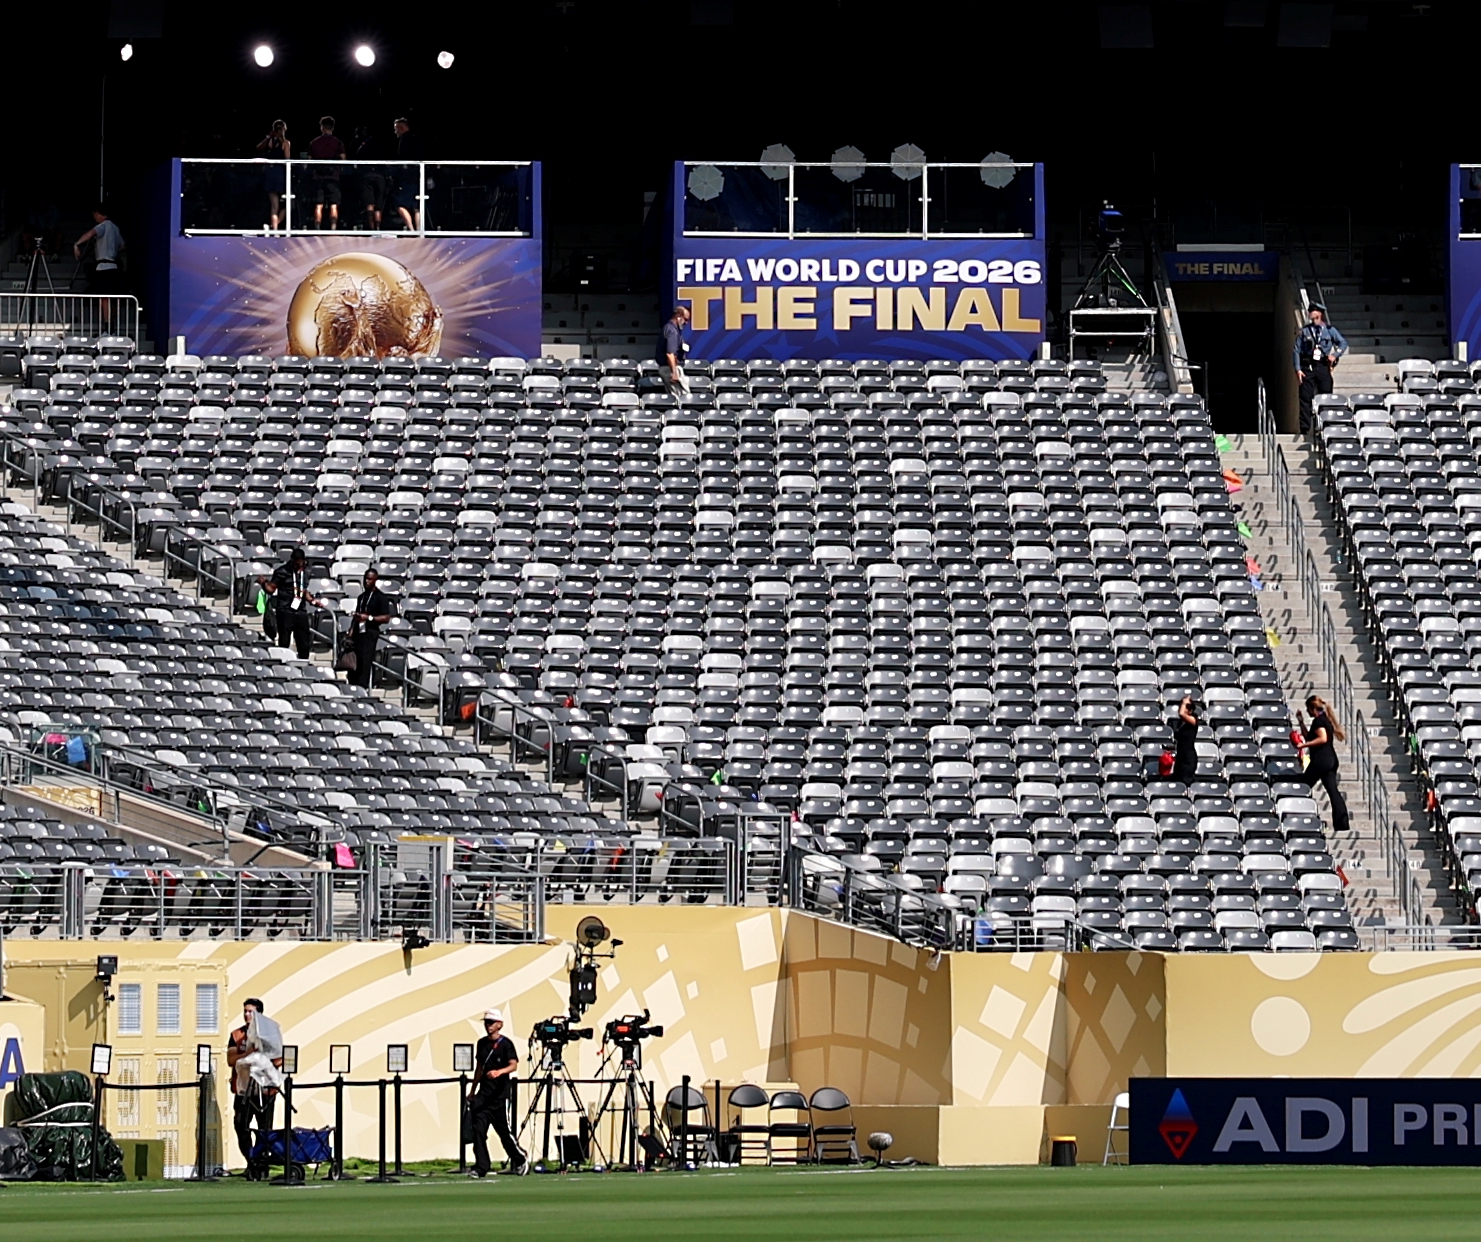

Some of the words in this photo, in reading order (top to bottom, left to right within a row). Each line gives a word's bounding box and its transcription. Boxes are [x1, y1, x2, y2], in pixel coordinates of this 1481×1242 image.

[676, 258, 743, 282] FIFA
[747, 258, 860, 283] WORLD
[866, 259, 928, 283] CUP
[933, 259, 1041, 284] 2026
[1175, 262, 1209, 275] THE
[1212, 262, 1264, 275] FINAL
[676, 286, 817, 331] THE
[833, 287, 1041, 333] FINAL
[1212, 1096, 1369, 1153] ADI
